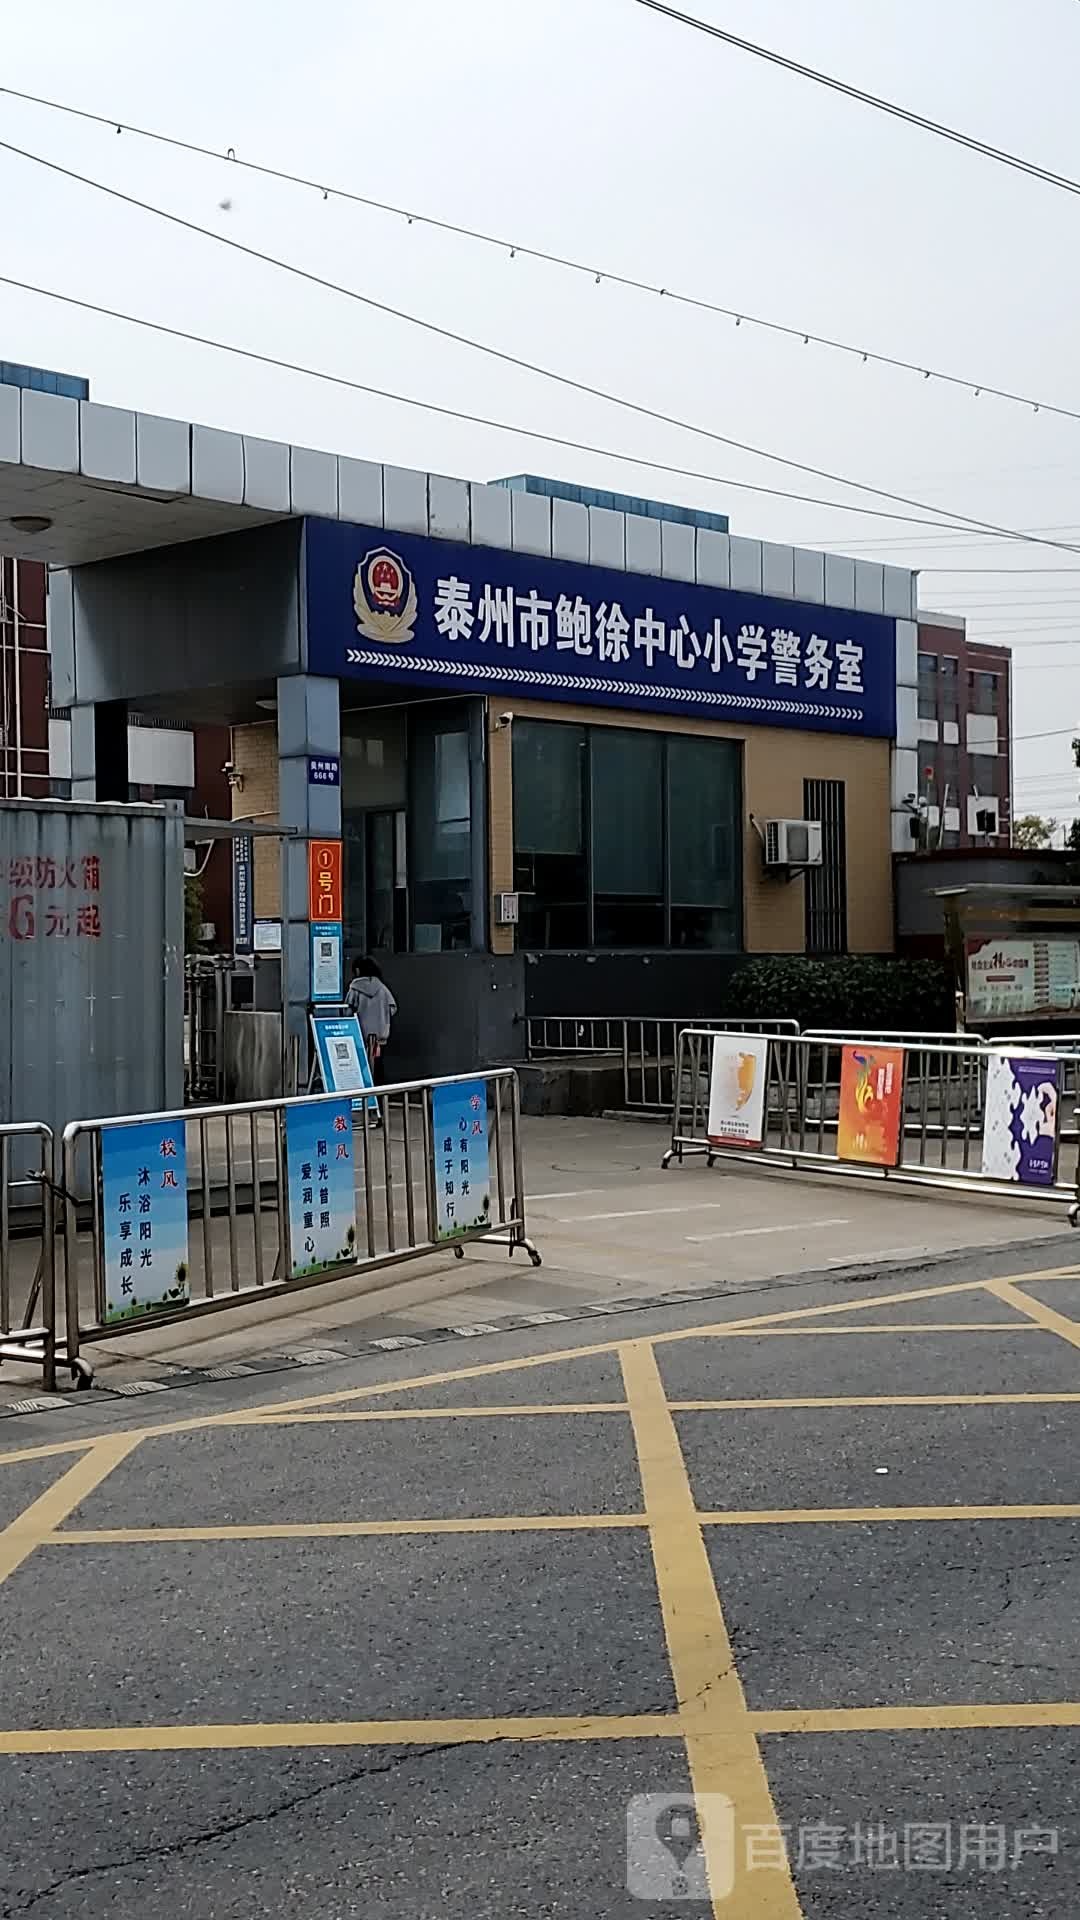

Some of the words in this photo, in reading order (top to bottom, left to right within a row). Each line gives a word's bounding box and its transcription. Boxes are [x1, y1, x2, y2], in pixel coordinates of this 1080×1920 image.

[434, 576, 864, 693] 泰州市鲍徐中心小学警务室
[334, 1116, 349, 1161] 教风
[459, 1117, 470, 1196] 心有阳光
[470, 1094, 483, 1135] 学风
[160, 1139, 178, 1188] 校风
[317, 1140, 330, 1229] 阳光普照
[443, 1137, 455, 1218] 成于知行
[118, 1193, 133, 1296] 乐享成长
[138, 1167, 152, 1268] 沐浴阳光
[301, 1163, 315, 1253] 爱润童心
